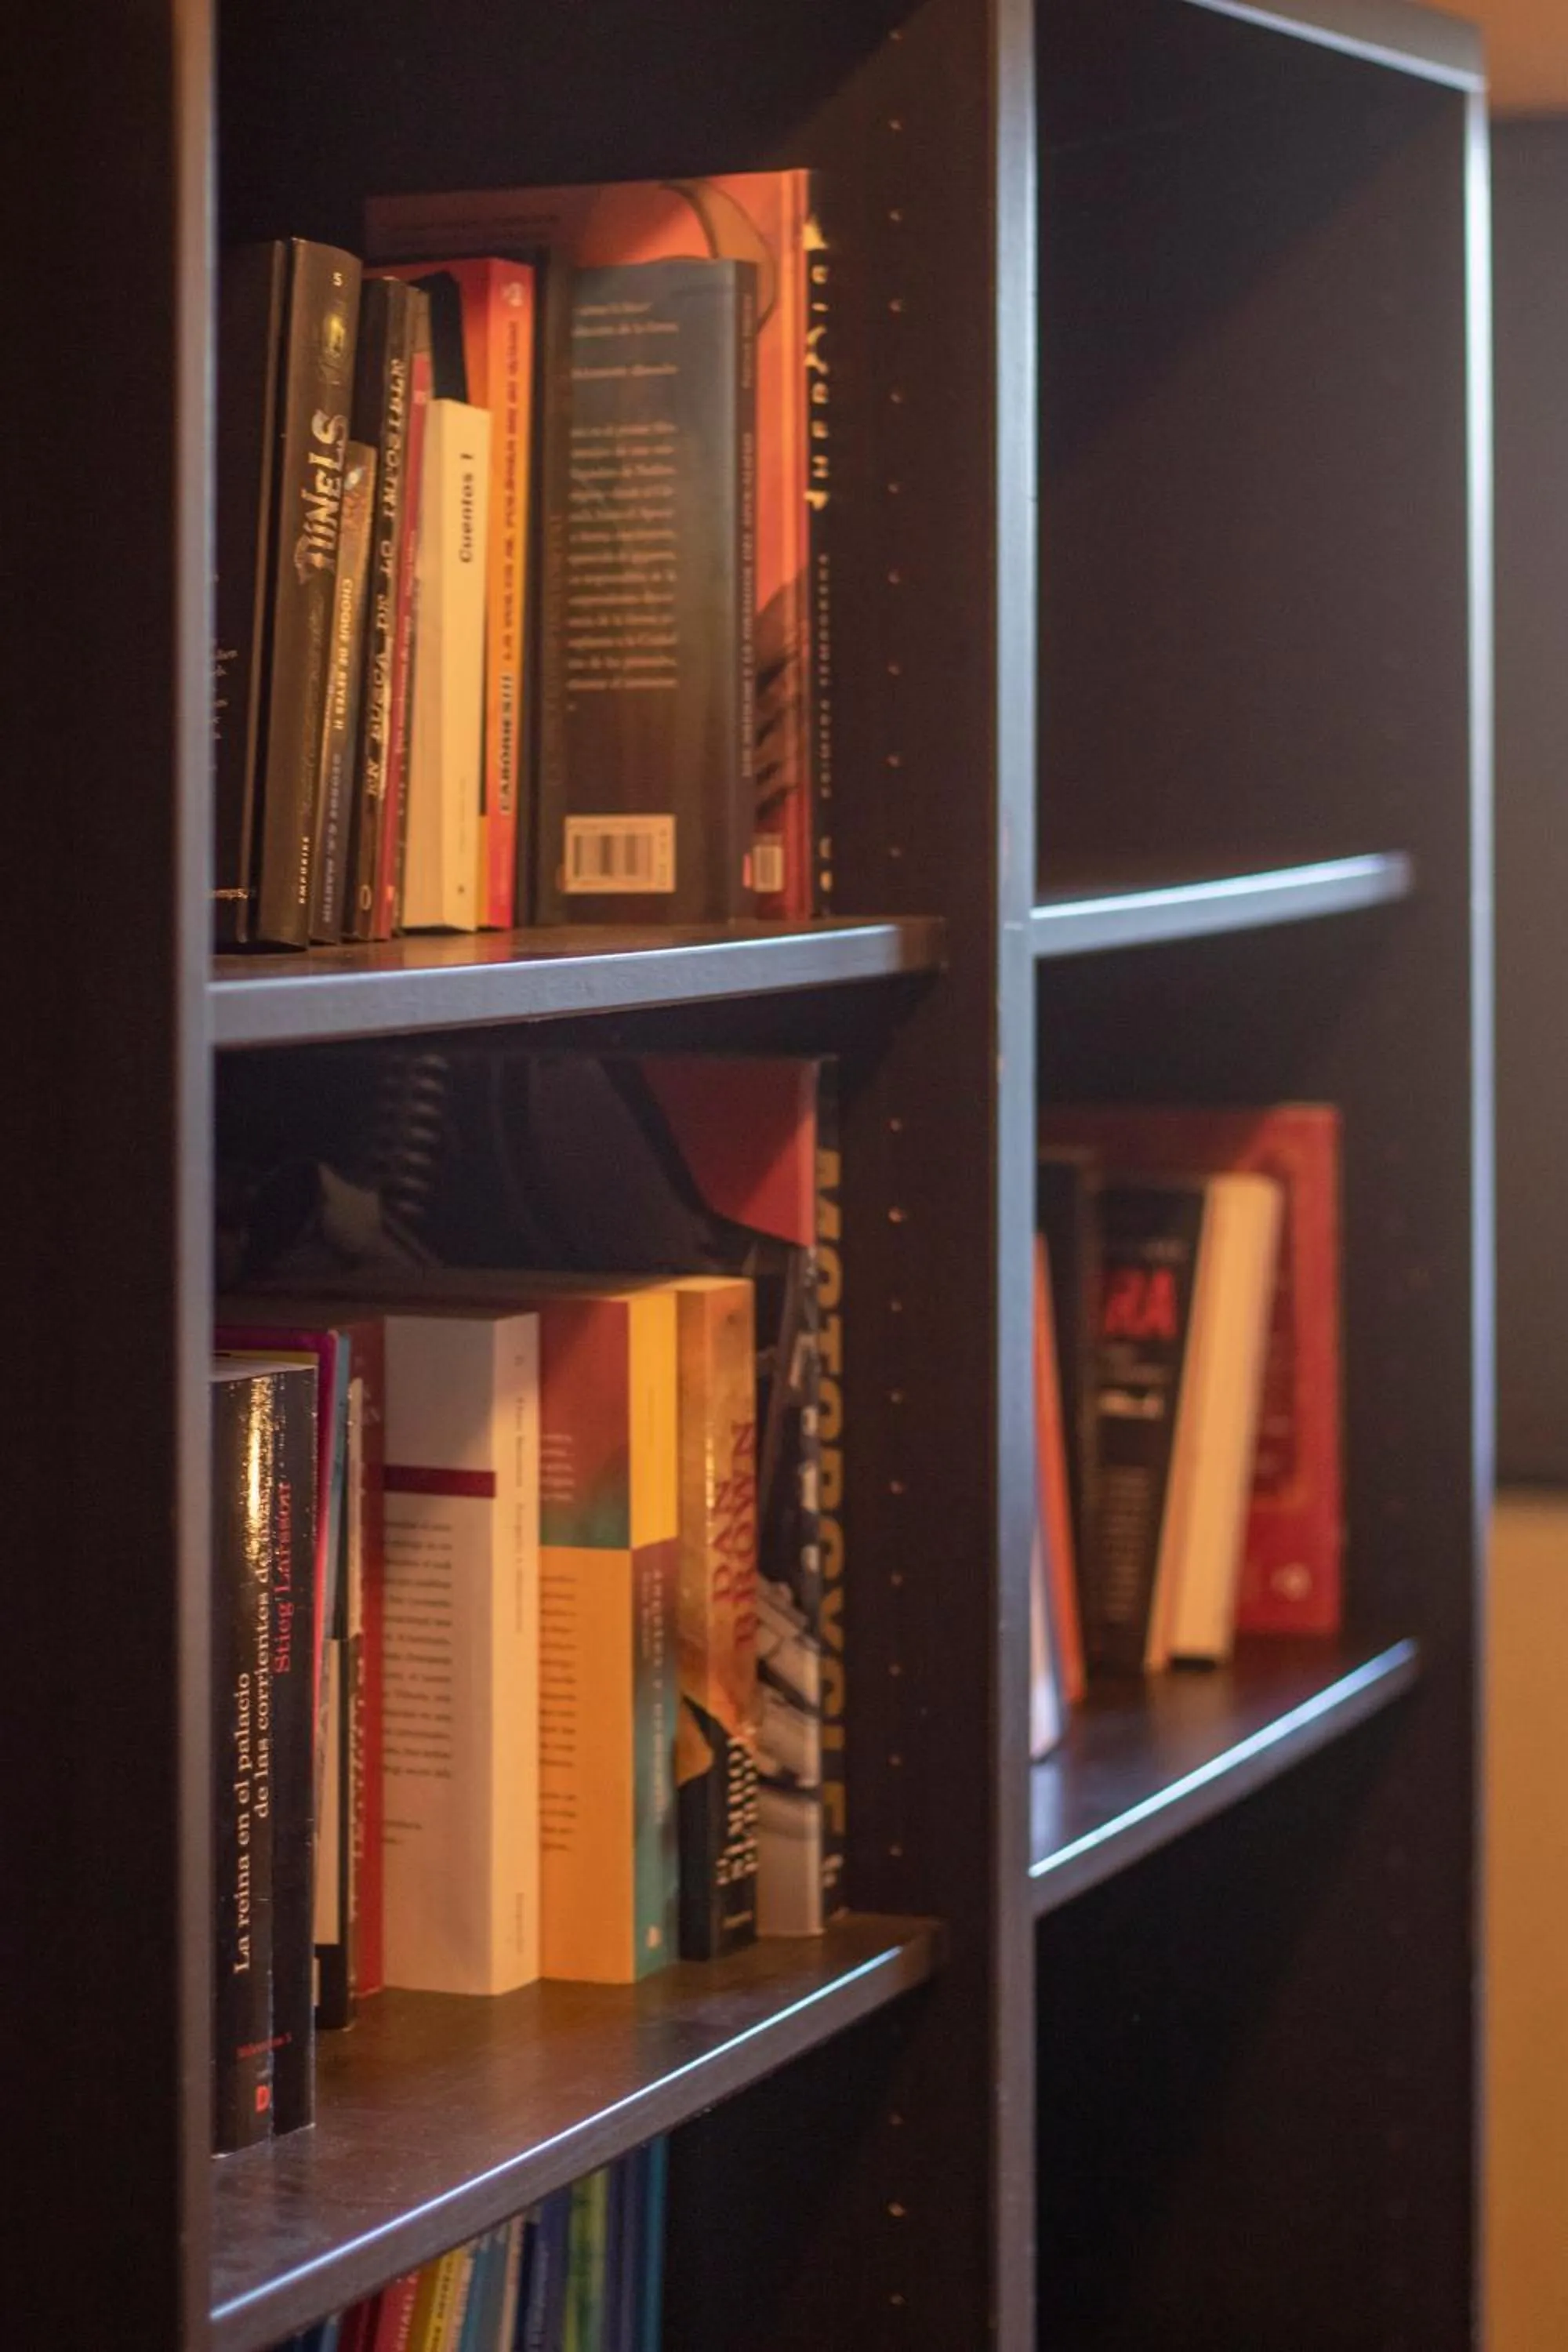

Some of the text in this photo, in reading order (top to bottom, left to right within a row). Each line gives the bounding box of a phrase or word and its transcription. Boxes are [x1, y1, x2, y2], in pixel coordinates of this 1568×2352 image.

[382, 358, 407, 517] IMPOSIBLE
[459, 474, 474, 564] Cuentos
[379, 539, 394, 578] LO
[338, 578, 353, 641] CHOQUE
[375, 593, 390, 631] DE
[334, 671, 348, 714] REYES
[338, 647, 350, 667] DE
[368, 652, 390, 742] BUSCA
[254, 1553, 270, 1584] de
[710, 1481, 731, 1603] DAN
[731, 1421, 760, 1650] BROWN
[273, 1481, 295, 1675] Stieg Larsson
[252, 1592, 271, 1731] corrientes
[252, 1738, 270, 1780] las
[234, 1671, 253, 1975] La reina en el palacio
[252, 1785, 270, 1819] de
